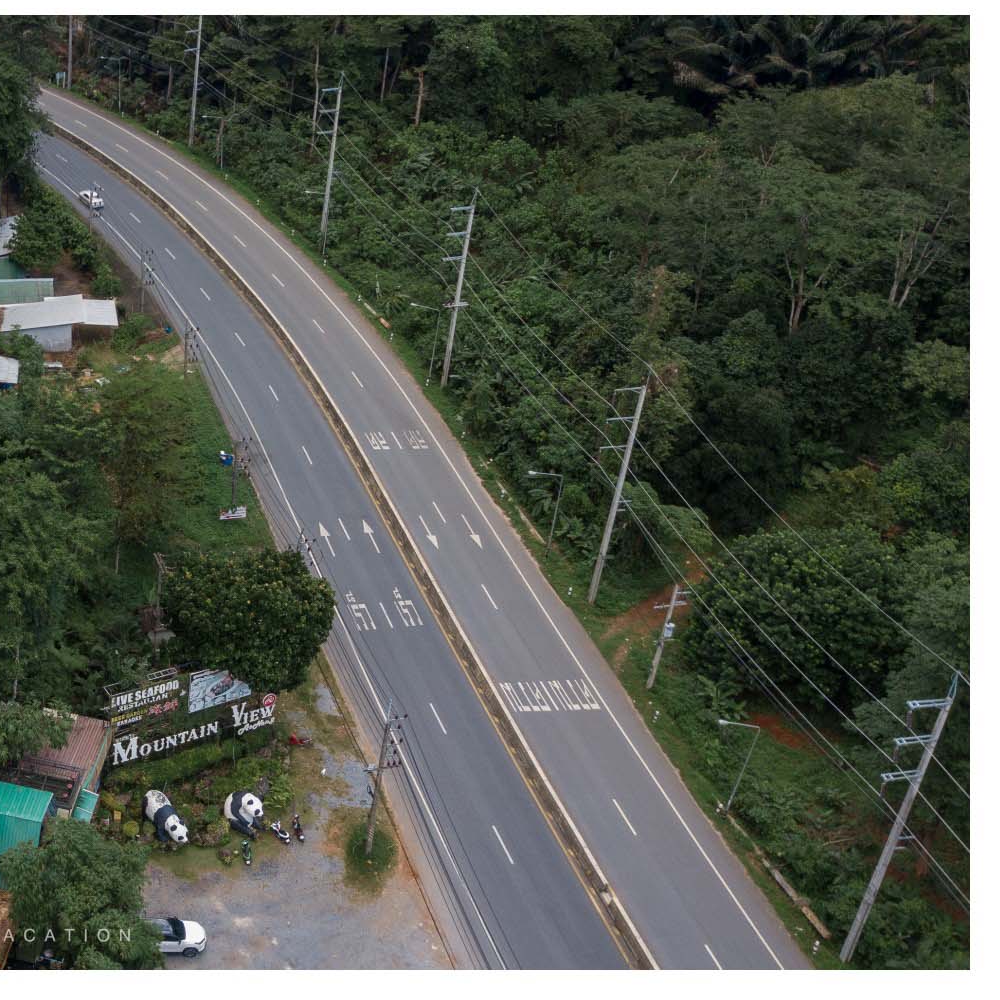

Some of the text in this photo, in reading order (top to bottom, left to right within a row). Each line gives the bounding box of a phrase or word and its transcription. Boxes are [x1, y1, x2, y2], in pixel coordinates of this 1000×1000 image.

[111, 680, 179, 708] LIVE SEAFOOD
[112, 702, 275, 766] MOUNTAIN VIEW
